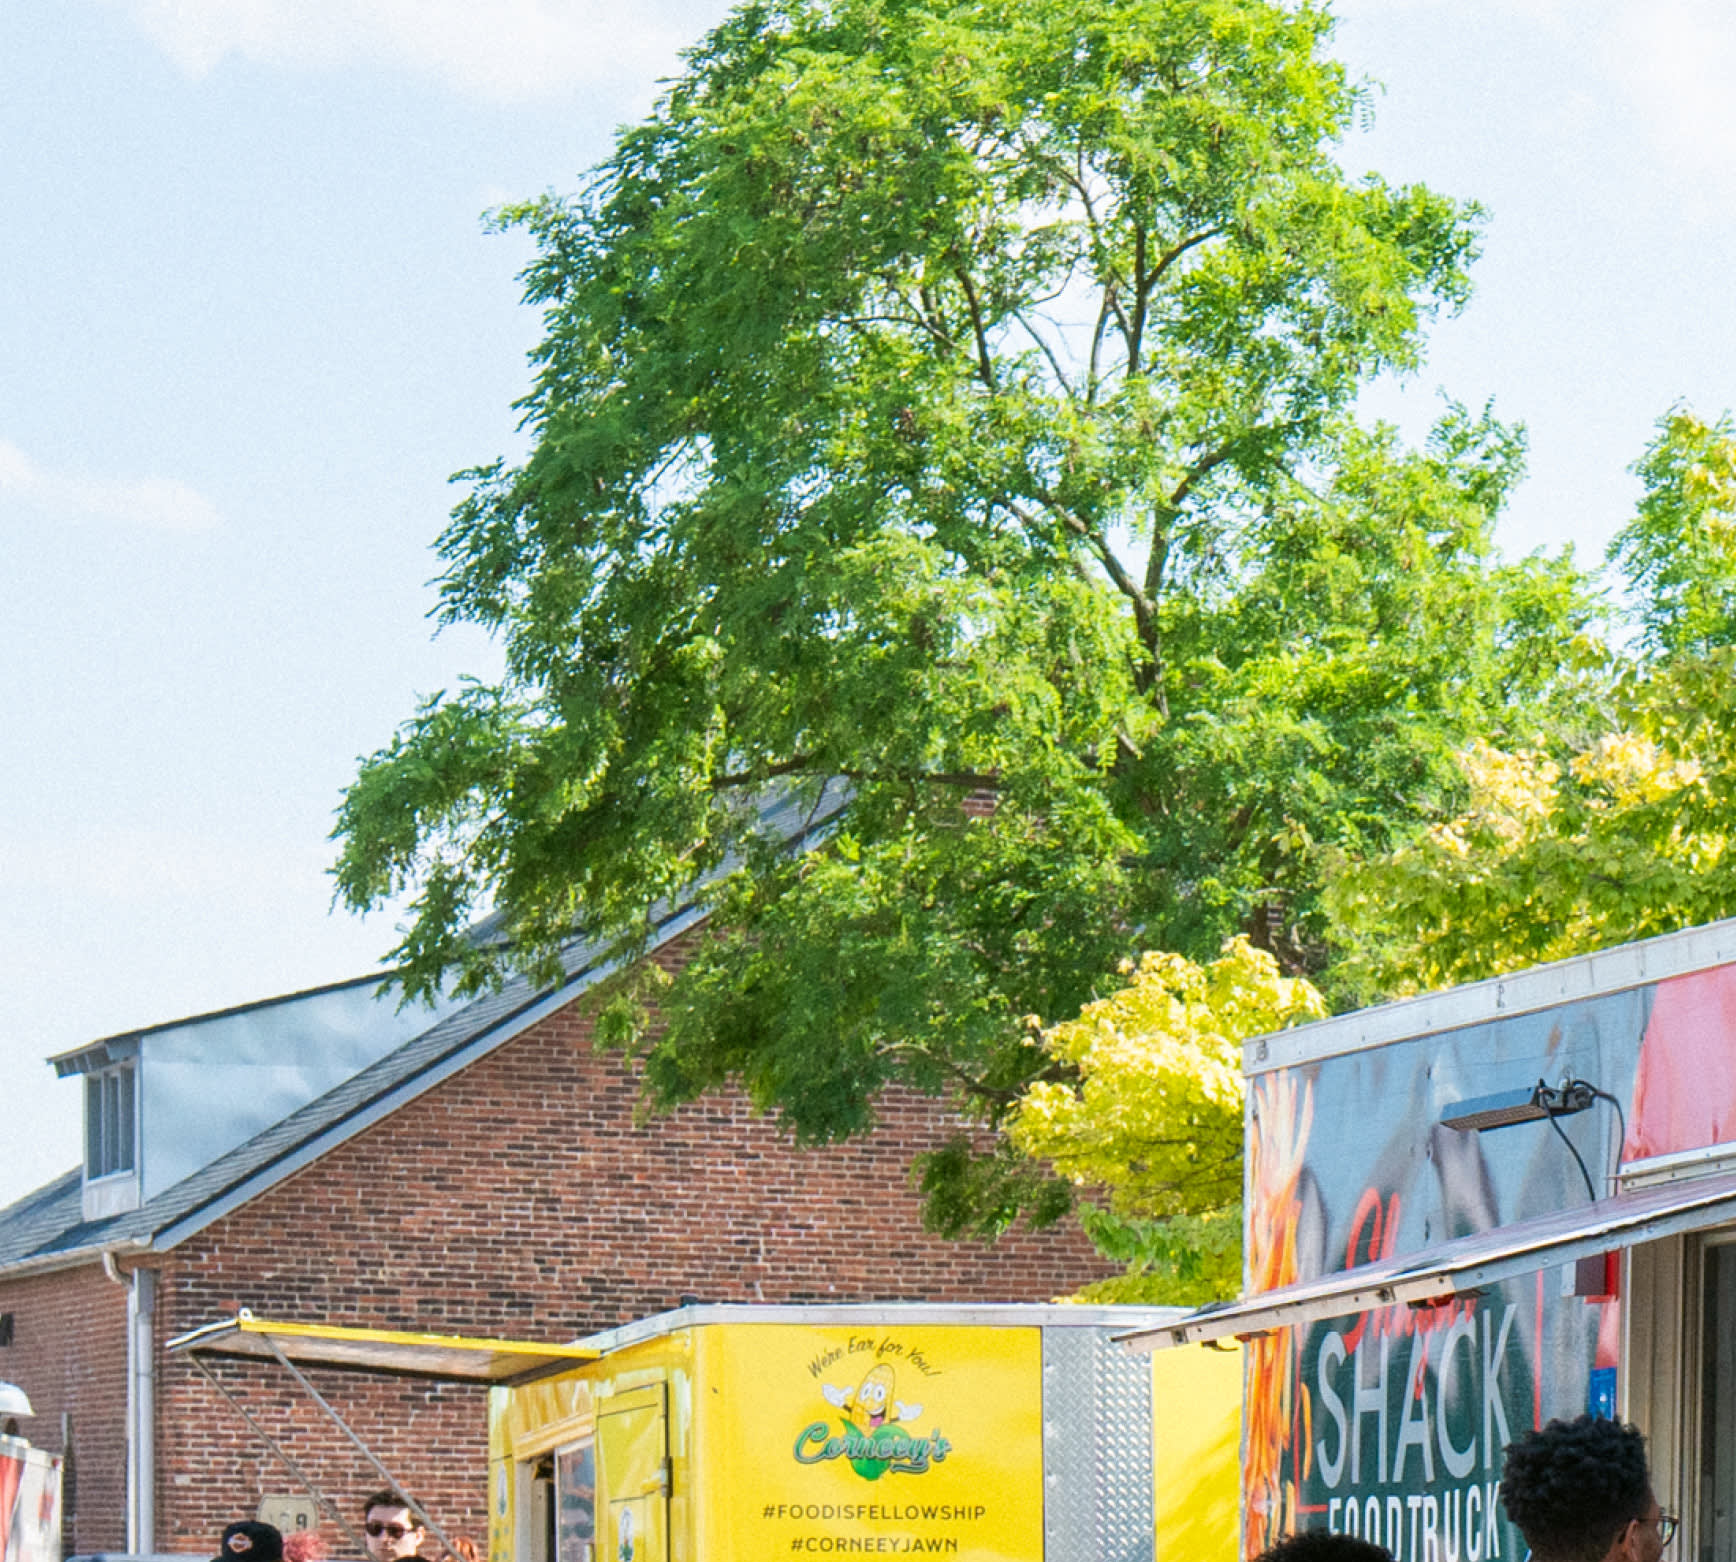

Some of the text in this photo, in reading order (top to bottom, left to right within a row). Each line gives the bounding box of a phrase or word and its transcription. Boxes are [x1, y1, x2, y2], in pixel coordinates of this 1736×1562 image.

[848, 1335, 875, 1354] Ear
[876, 1336, 903, 1358] for
[906, 1347, 943, 1377] You!
[1317, 1303, 1517, 1489] SHACK
[762, 1503, 986, 1521] #FOODISFELLOWSHIP
[790, 1536, 958, 1553] #CORNEEYJAWN
